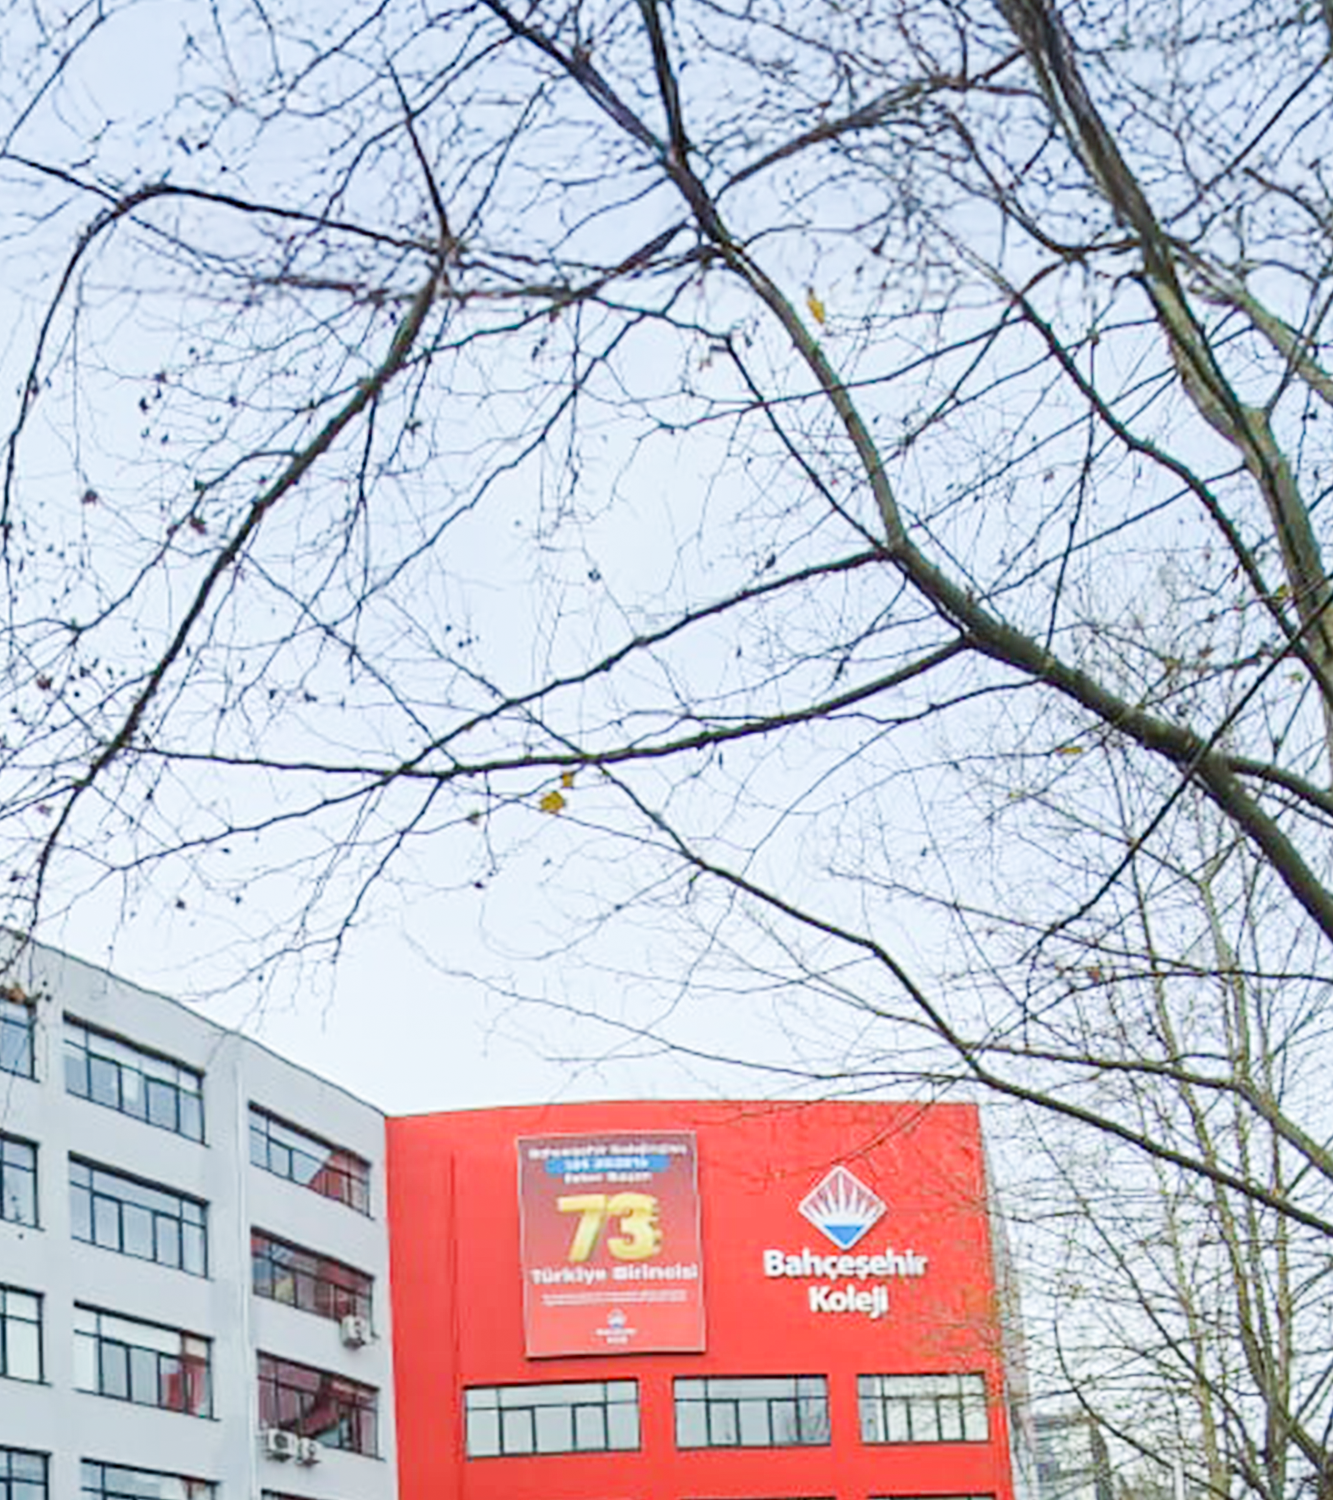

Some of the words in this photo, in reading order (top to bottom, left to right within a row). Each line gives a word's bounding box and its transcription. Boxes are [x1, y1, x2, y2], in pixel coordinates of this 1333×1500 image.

[556, 1192, 658, 1262] 73
[763, 1247, 928, 1280] Bahçeşehir
[808, 1284, 889, 1319] Koleji
